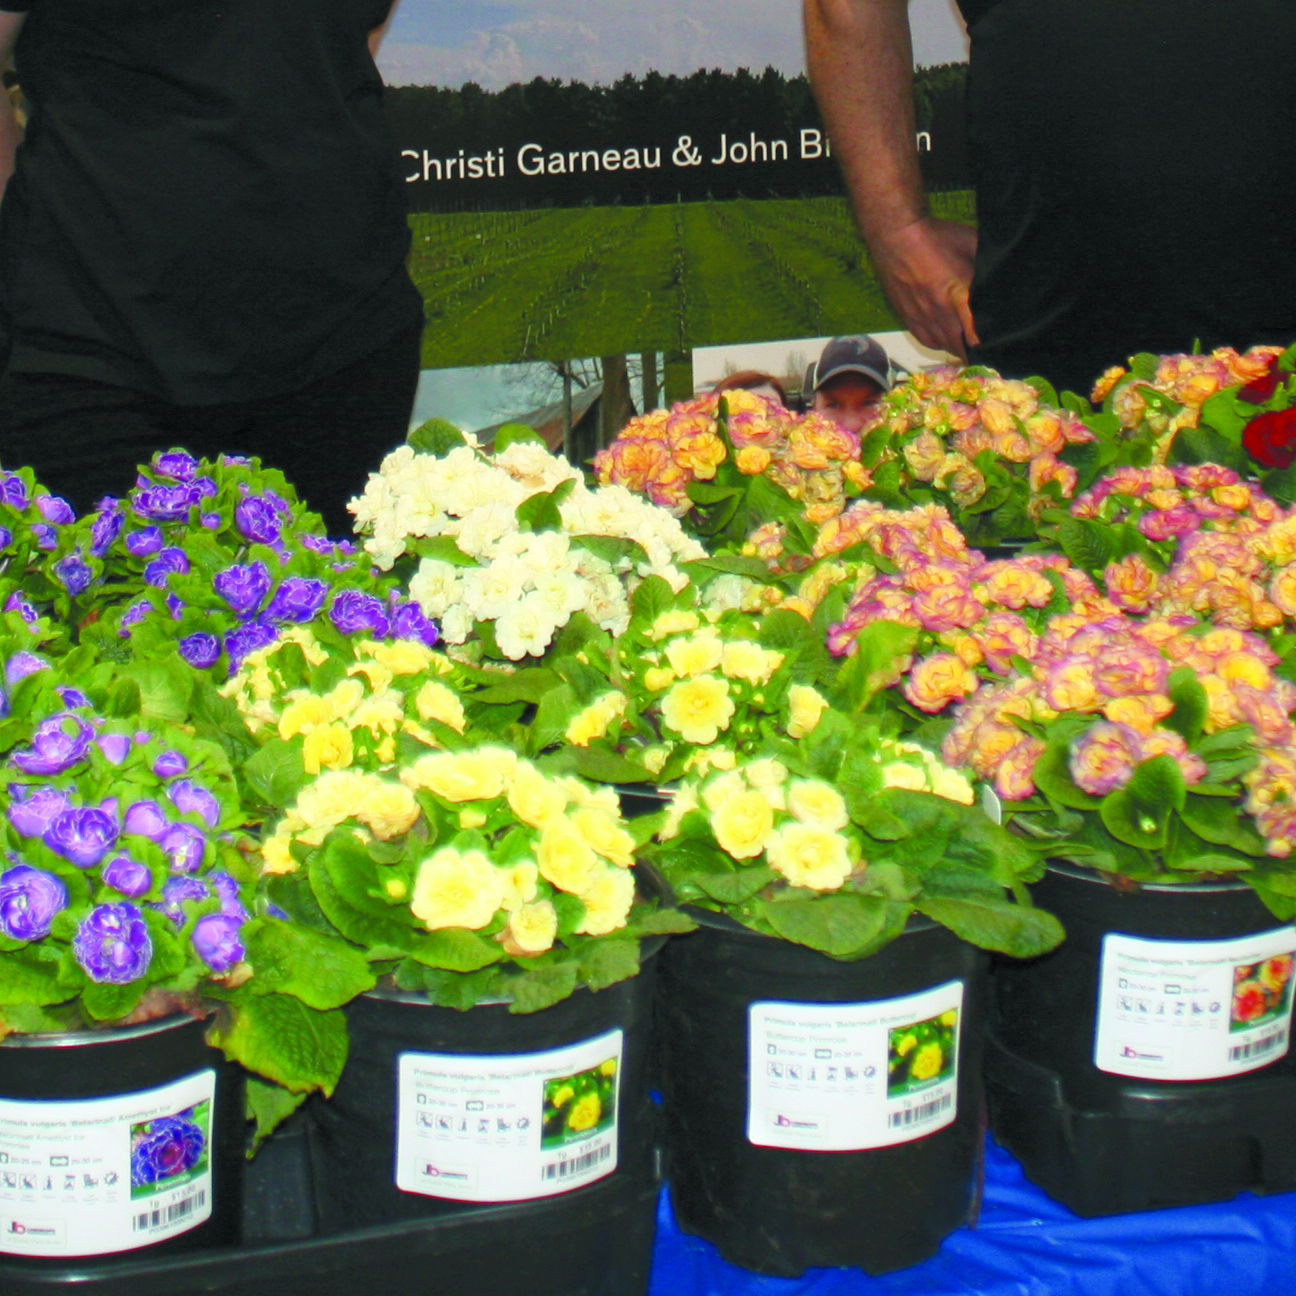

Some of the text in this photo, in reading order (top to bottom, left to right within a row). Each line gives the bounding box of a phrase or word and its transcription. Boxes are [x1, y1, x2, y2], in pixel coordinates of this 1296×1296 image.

[401, 146, 505, 183] Christi
[516, 143, 663, 176] Garneau
[671, 136, 703, 167] &
[711, 131, 789, 166] John
